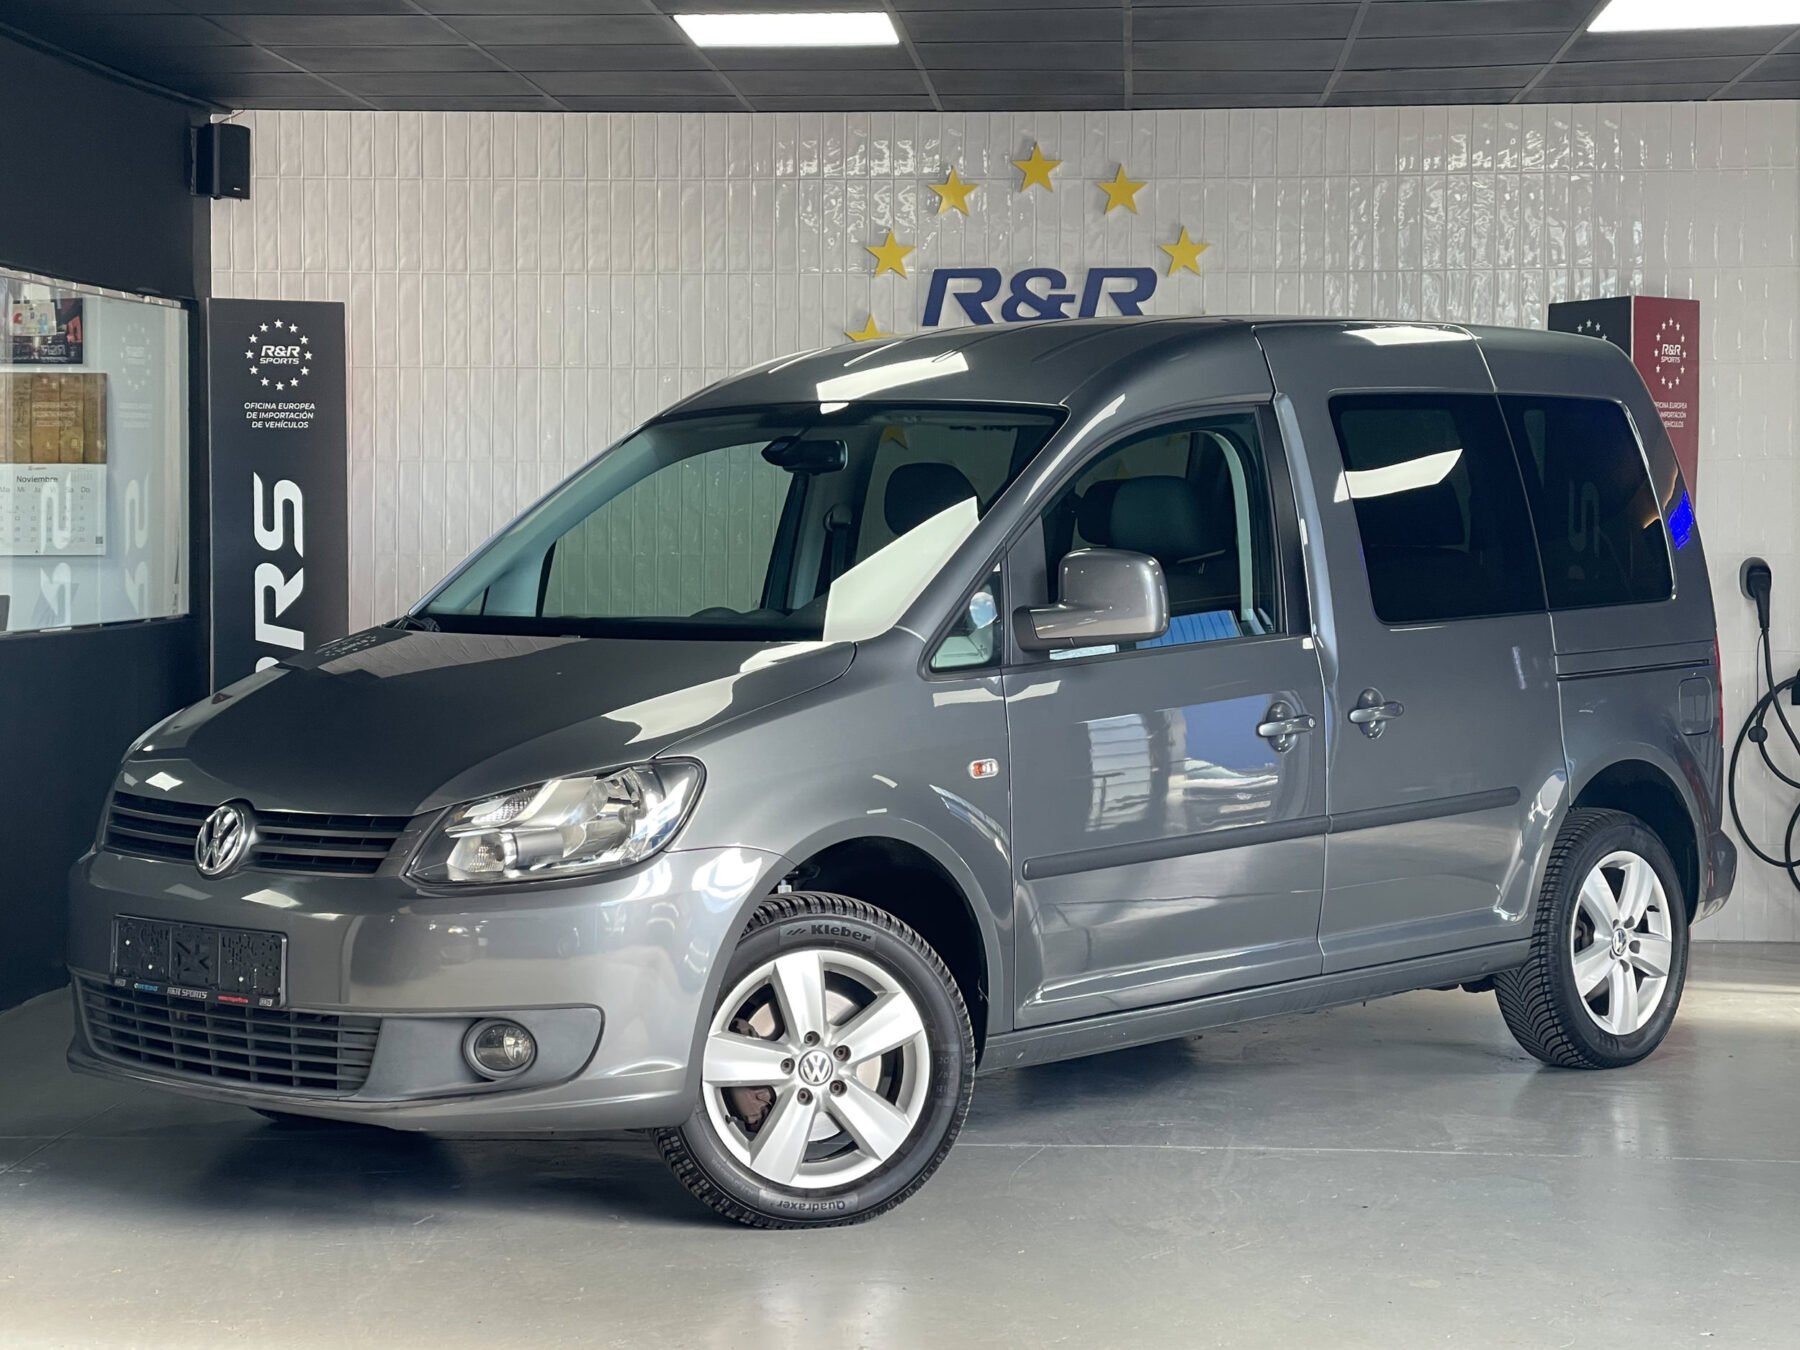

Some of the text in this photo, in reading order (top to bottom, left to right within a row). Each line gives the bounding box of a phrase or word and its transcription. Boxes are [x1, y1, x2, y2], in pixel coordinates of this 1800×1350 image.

[922, 267, 1158, 327] R&R
[261, 345, 300, 357] R&R
[1661, 343, 1681, 355] R&R
[259, 357, 300, 365] SPORTS
[243, 402, 316, 410] OFICINA EUROPEA
[246, 410, 314, 419] DE IMPORTACIÓN
[251, 420, 309, 429] DE VEHÍCULOS
[16, 475, 59, 484] Noviembre
[811, 924, 872, 942] Kleber
[777, 1199, 846, 1213] Quadraxer
